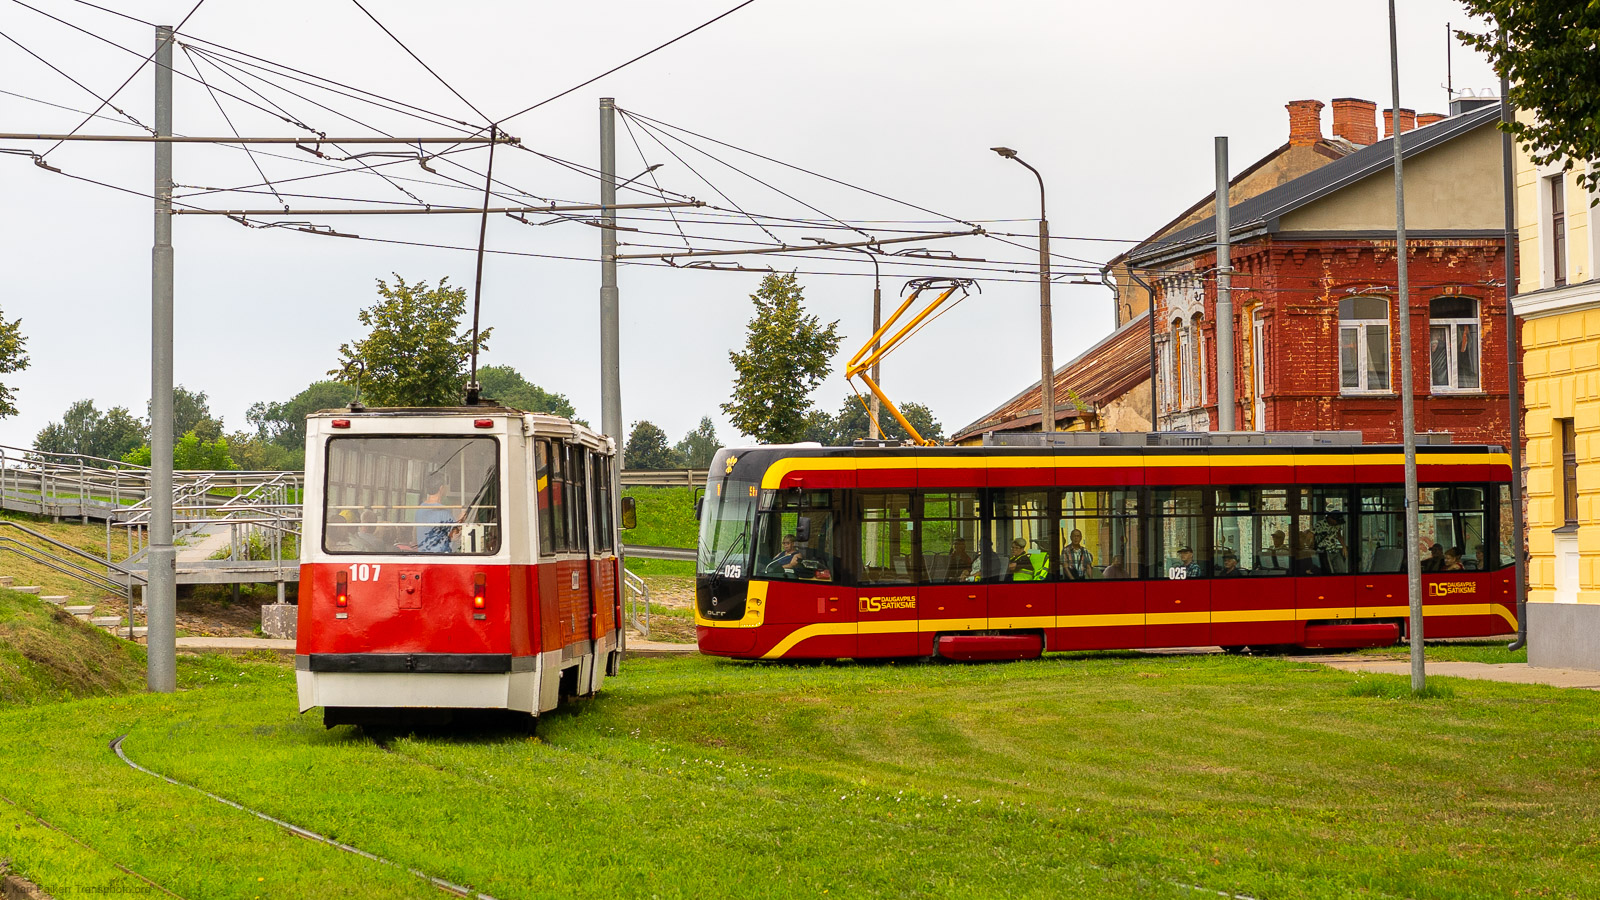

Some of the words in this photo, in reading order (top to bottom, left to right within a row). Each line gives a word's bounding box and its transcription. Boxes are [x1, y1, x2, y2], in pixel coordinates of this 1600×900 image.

[468, 529, 477, 553] 1
[349, 564, 381, 582] 107
[724, 564, 742, 579] 025
[1168, 567, 1187, 580] 025
